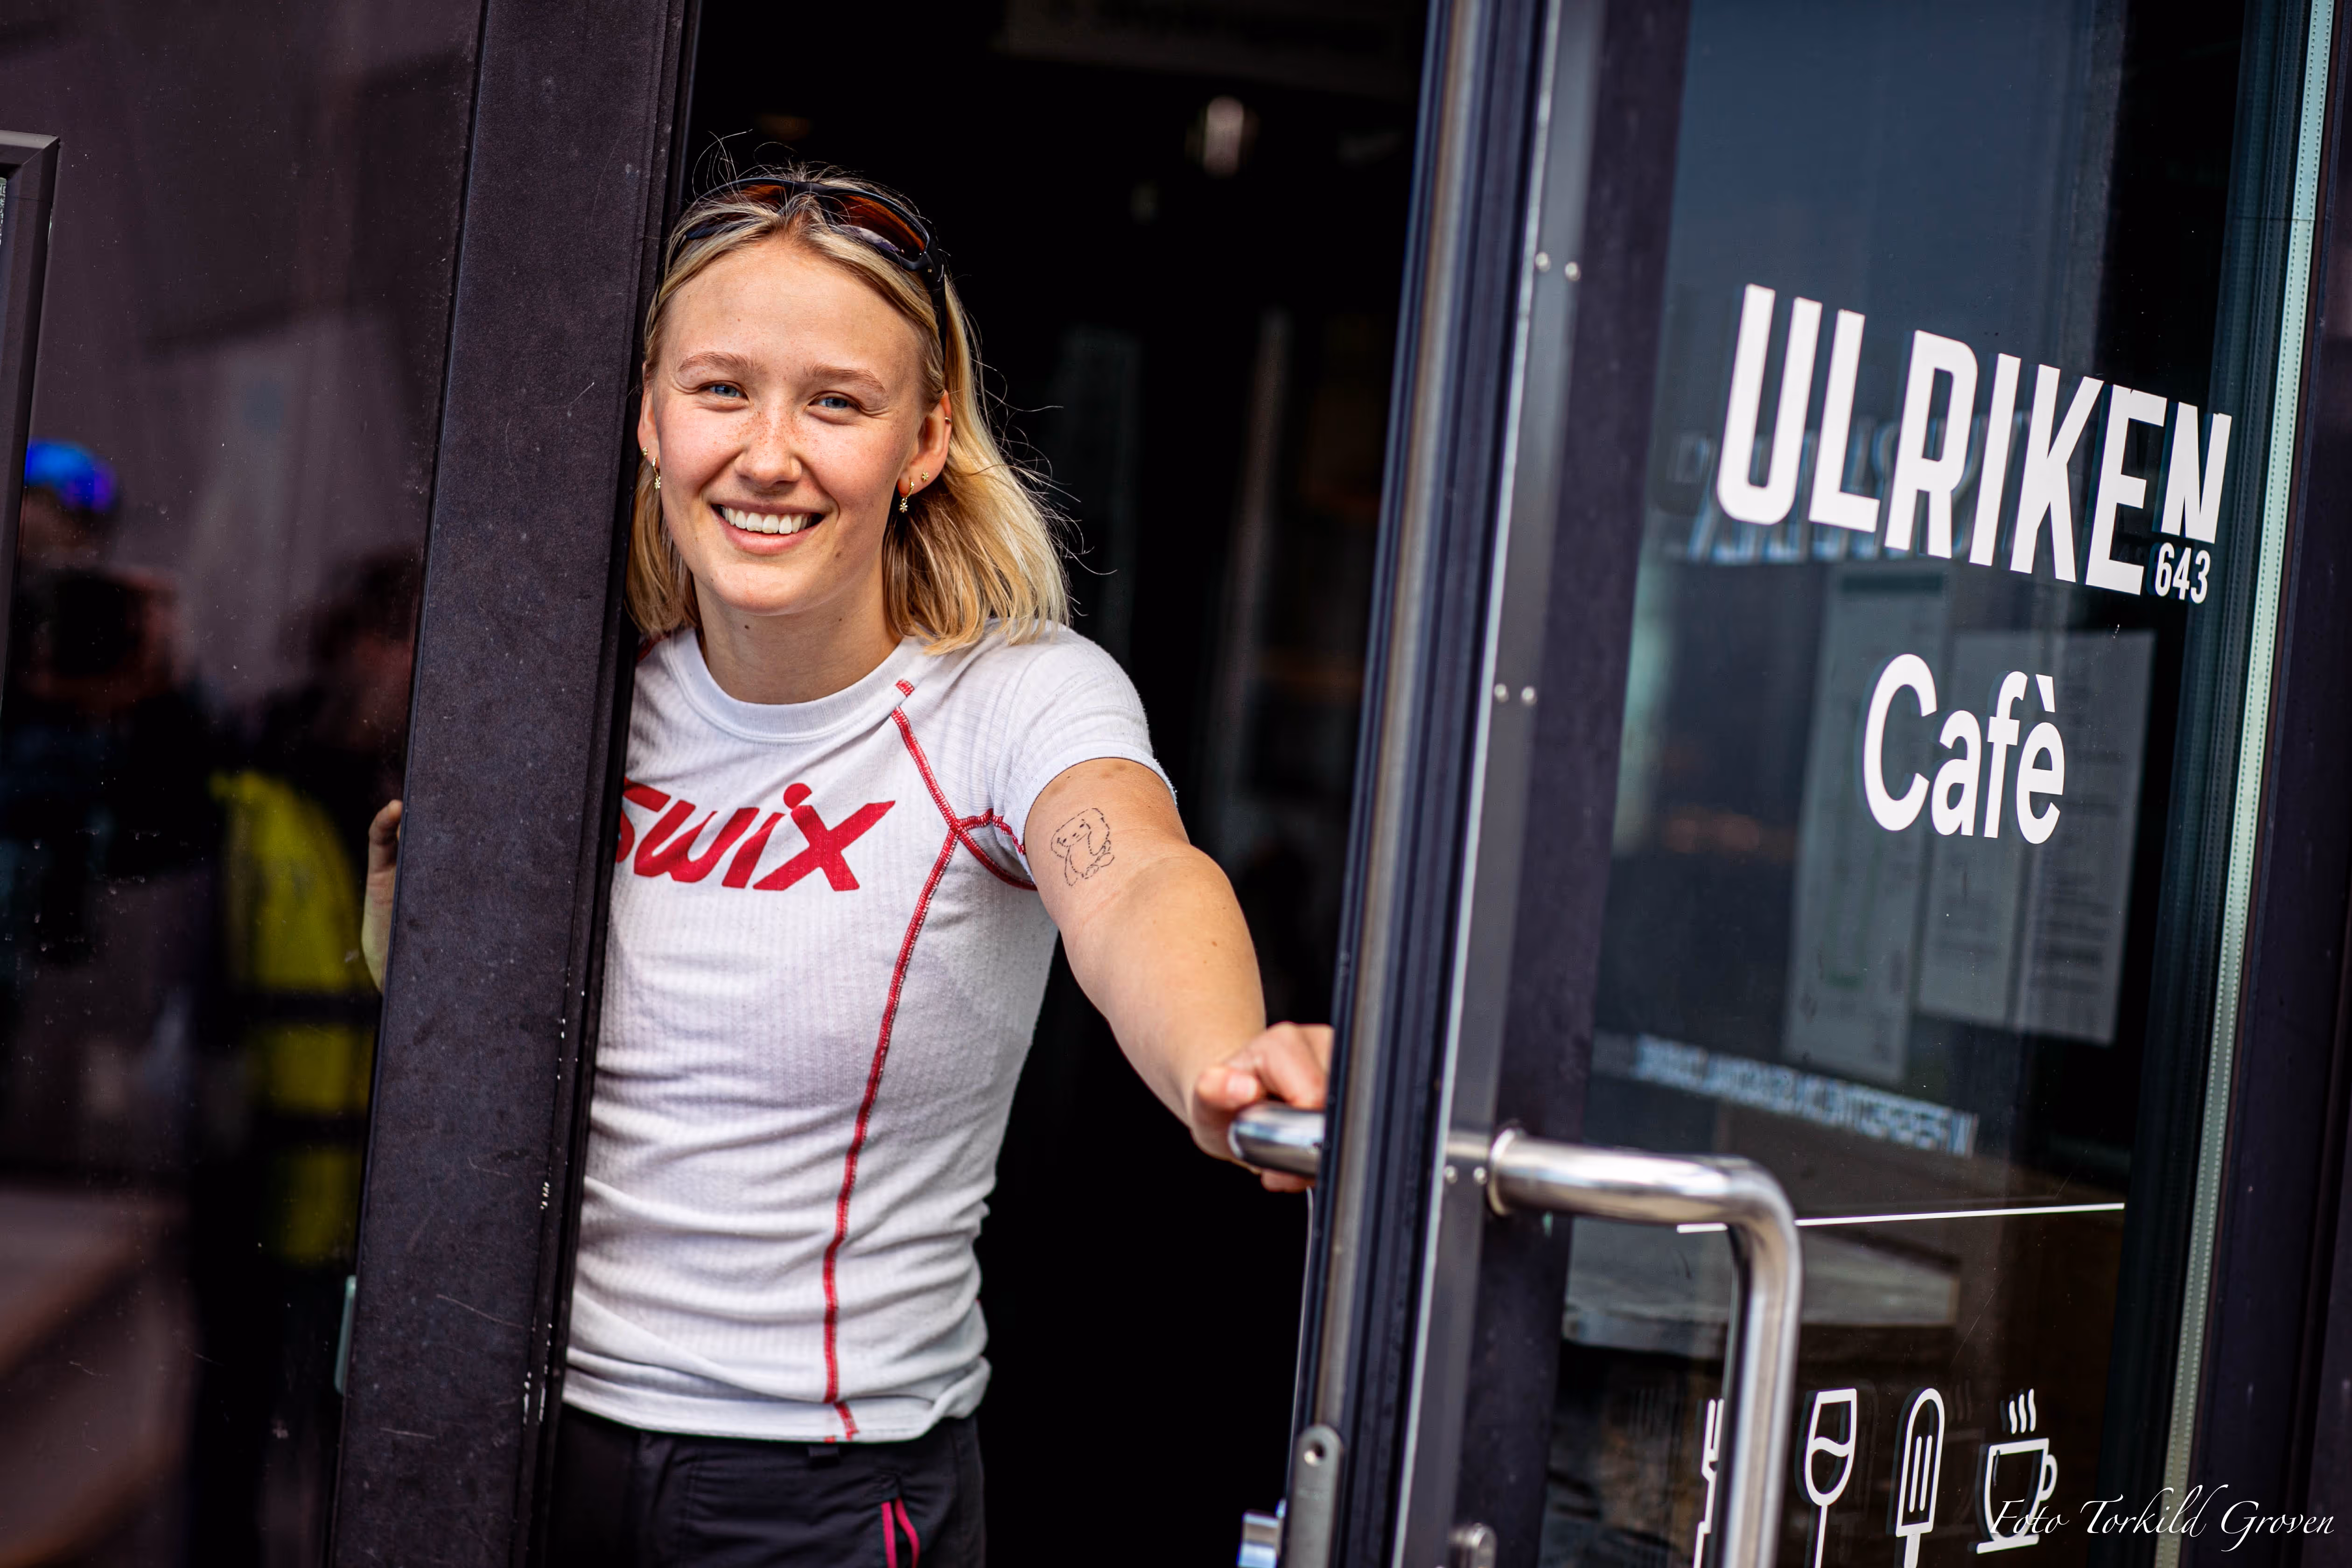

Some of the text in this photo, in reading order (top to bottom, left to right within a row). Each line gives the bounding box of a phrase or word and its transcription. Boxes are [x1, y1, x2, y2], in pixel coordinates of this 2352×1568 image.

[1717, 283, 2233, 595] ULRIKEN
[2155, 542, 2211, 603] 643
[1864, 653, 2065, 844] Cafè
